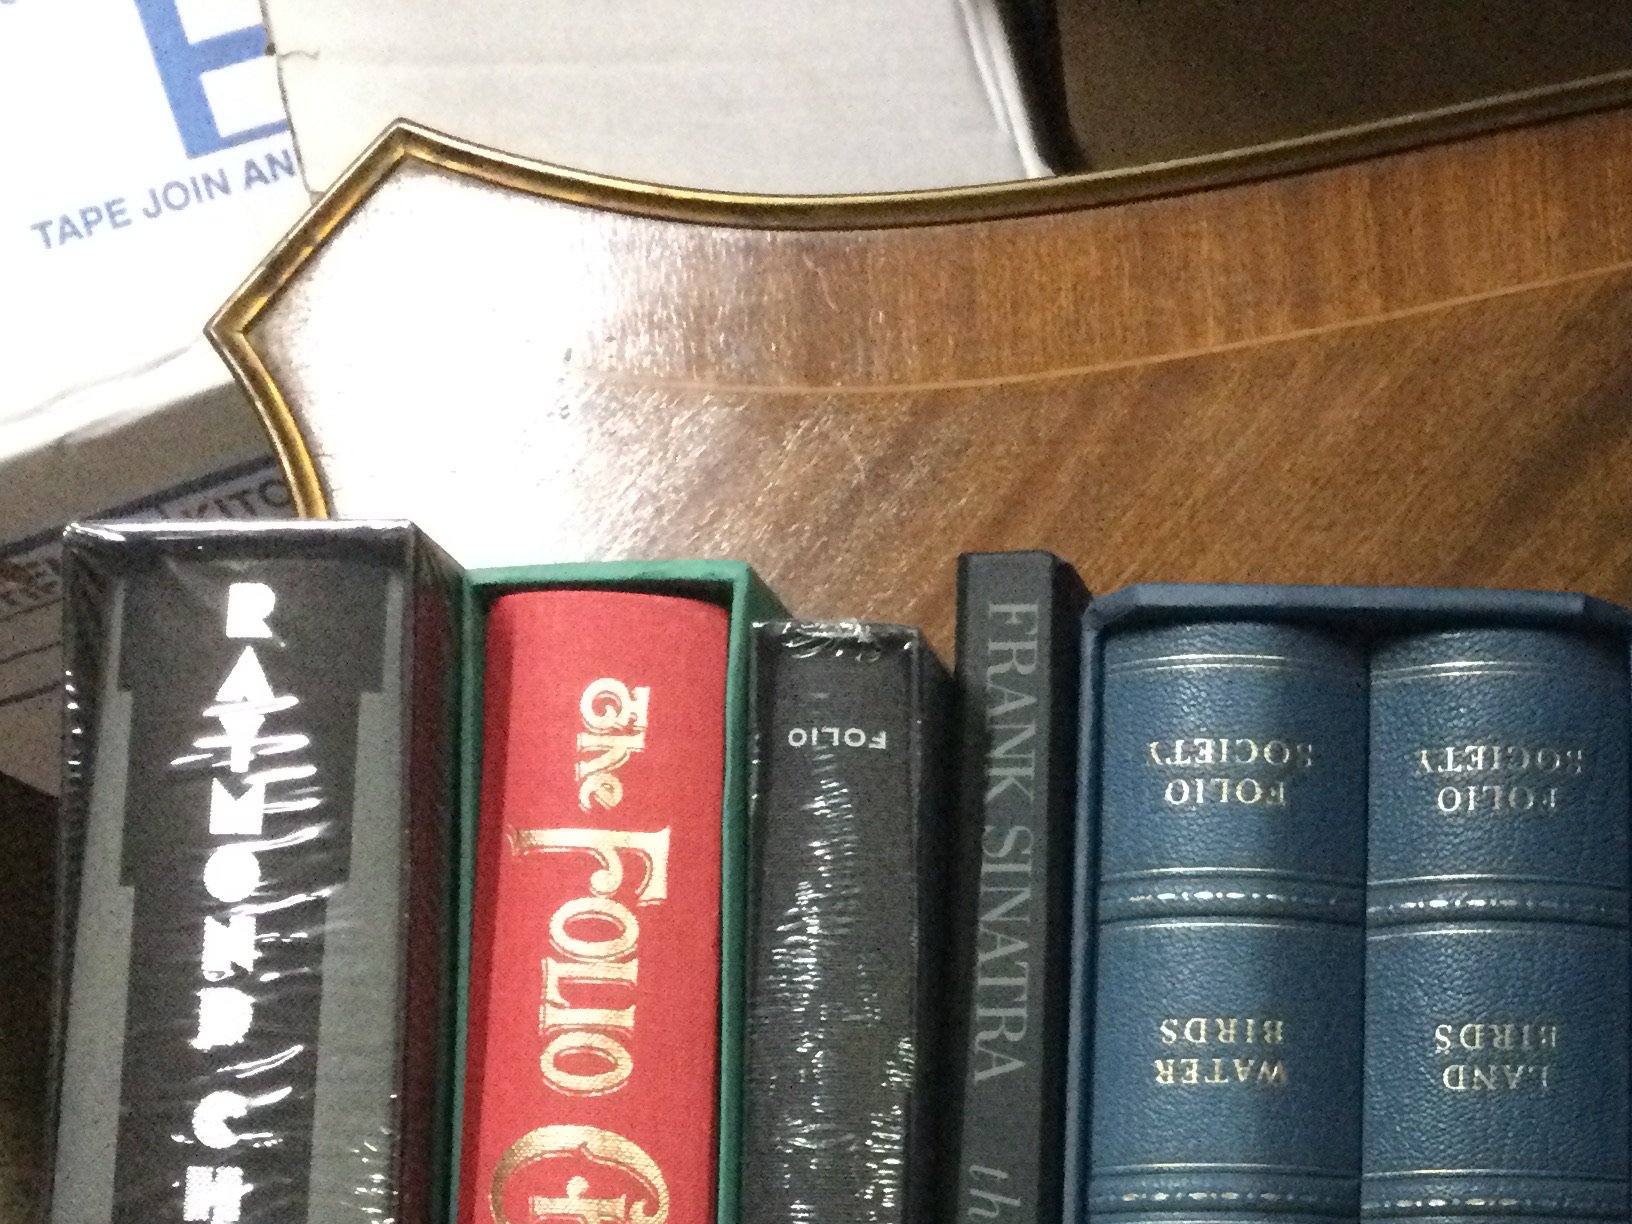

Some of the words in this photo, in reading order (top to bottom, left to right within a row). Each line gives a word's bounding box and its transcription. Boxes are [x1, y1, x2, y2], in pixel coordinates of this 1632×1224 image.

[30, 196, 133, 252] TAPE
[142, 166, 234, 220] JOIN
[982, 602, 1041, 803] FRANK
[578, 677, 651, 811] The
[787, 726, 888, 750] FOLIO
[1148, 737, 1313, 769] SOCIETY
[1416, 745, 1584, 775] SOCIETY
[1164, 778, 1287, 808] FOLIO
[1436, 784, 1558, 812] FOLIO
[193, 582, 277, 1050] RAYMOND
[505, 826, 671, 1097] FOLIO
[973, 824, 1048, 1086] SINATRA
[1159, 1017, 1284, 1045] BIRDS
[1434, 1023, 1558, 1051] BIRDS
[1154, 1059, 1288, 1086] WATER
[1442, 1063, 1550, 1091] LAND
